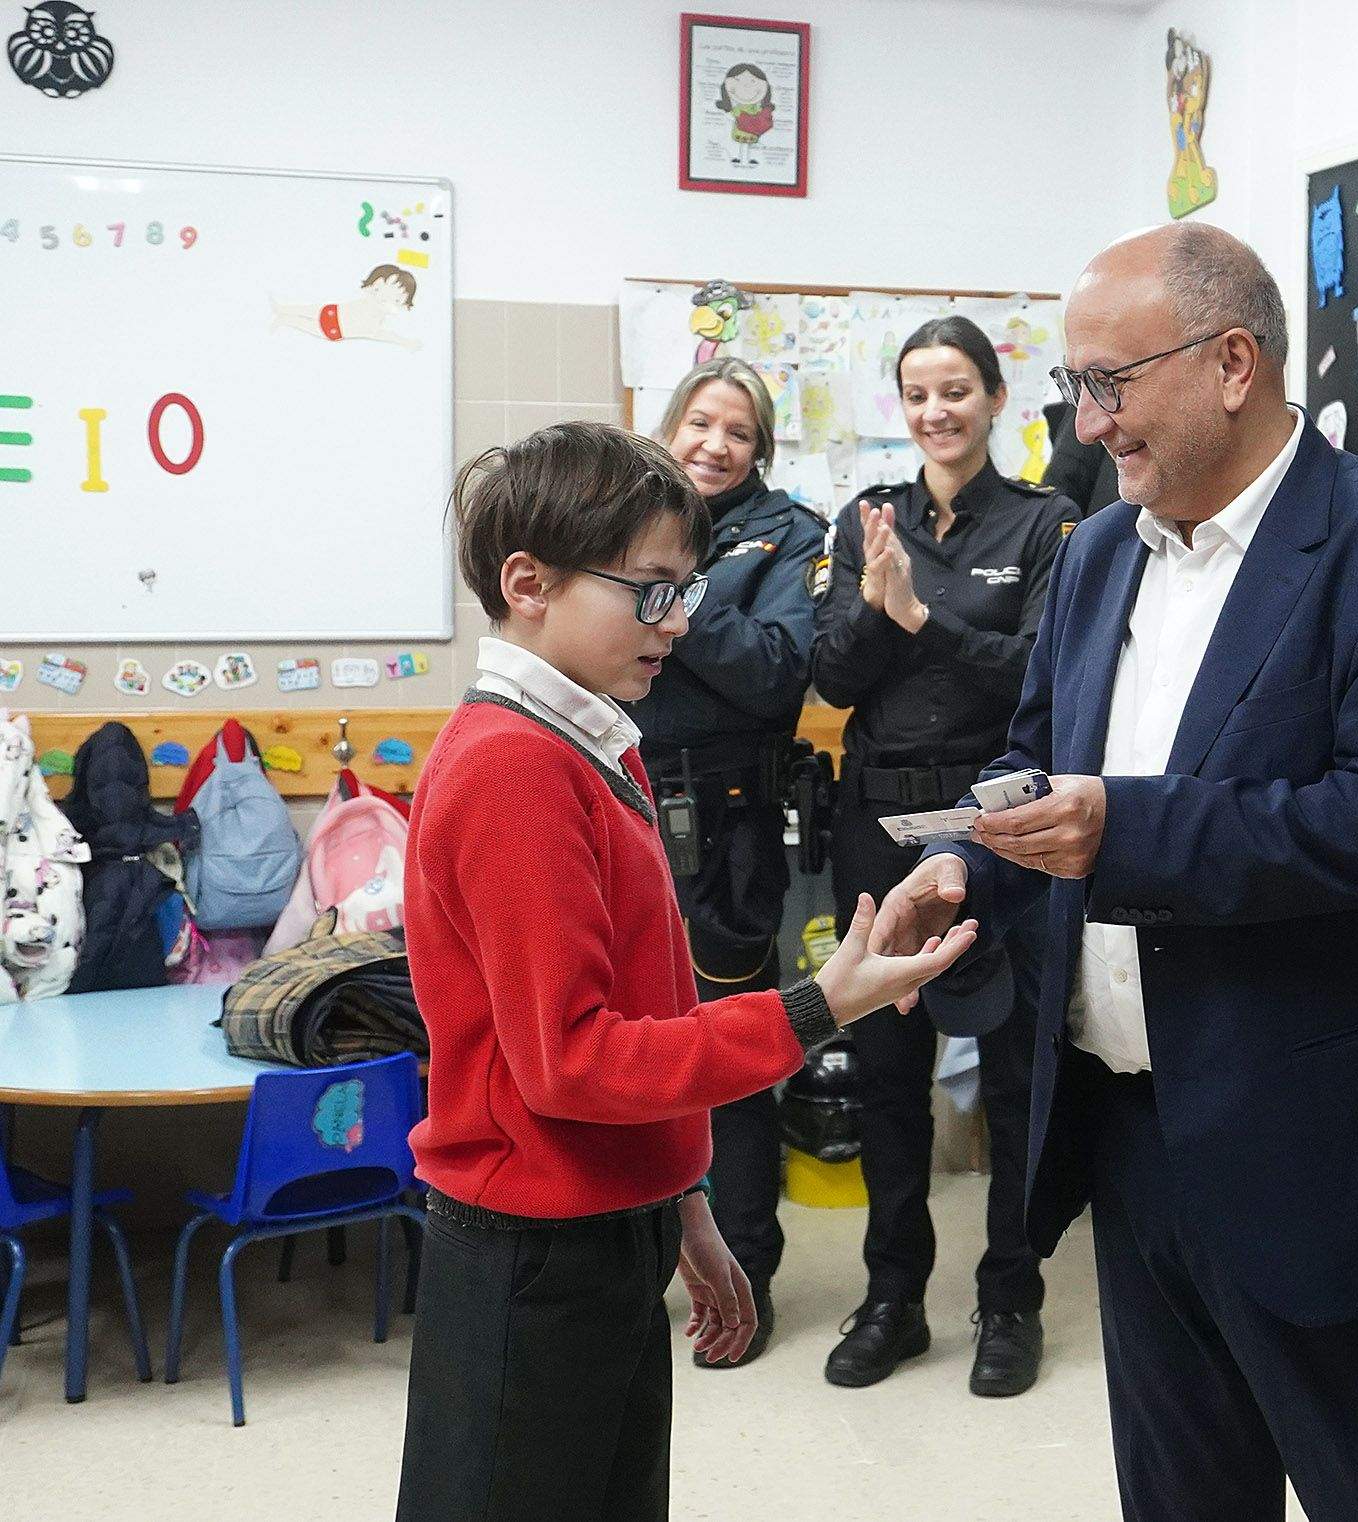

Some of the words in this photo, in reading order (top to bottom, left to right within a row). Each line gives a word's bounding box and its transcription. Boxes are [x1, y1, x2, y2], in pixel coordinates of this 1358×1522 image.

[40, 224, 60, 250] 5
[72, 222, 93, 247] 6
[106, 221, 126, 247] 7
[146, 220, 164, 245] 8
[179, 226, 198, 250] 9
[78, 408, 109, 493] I
